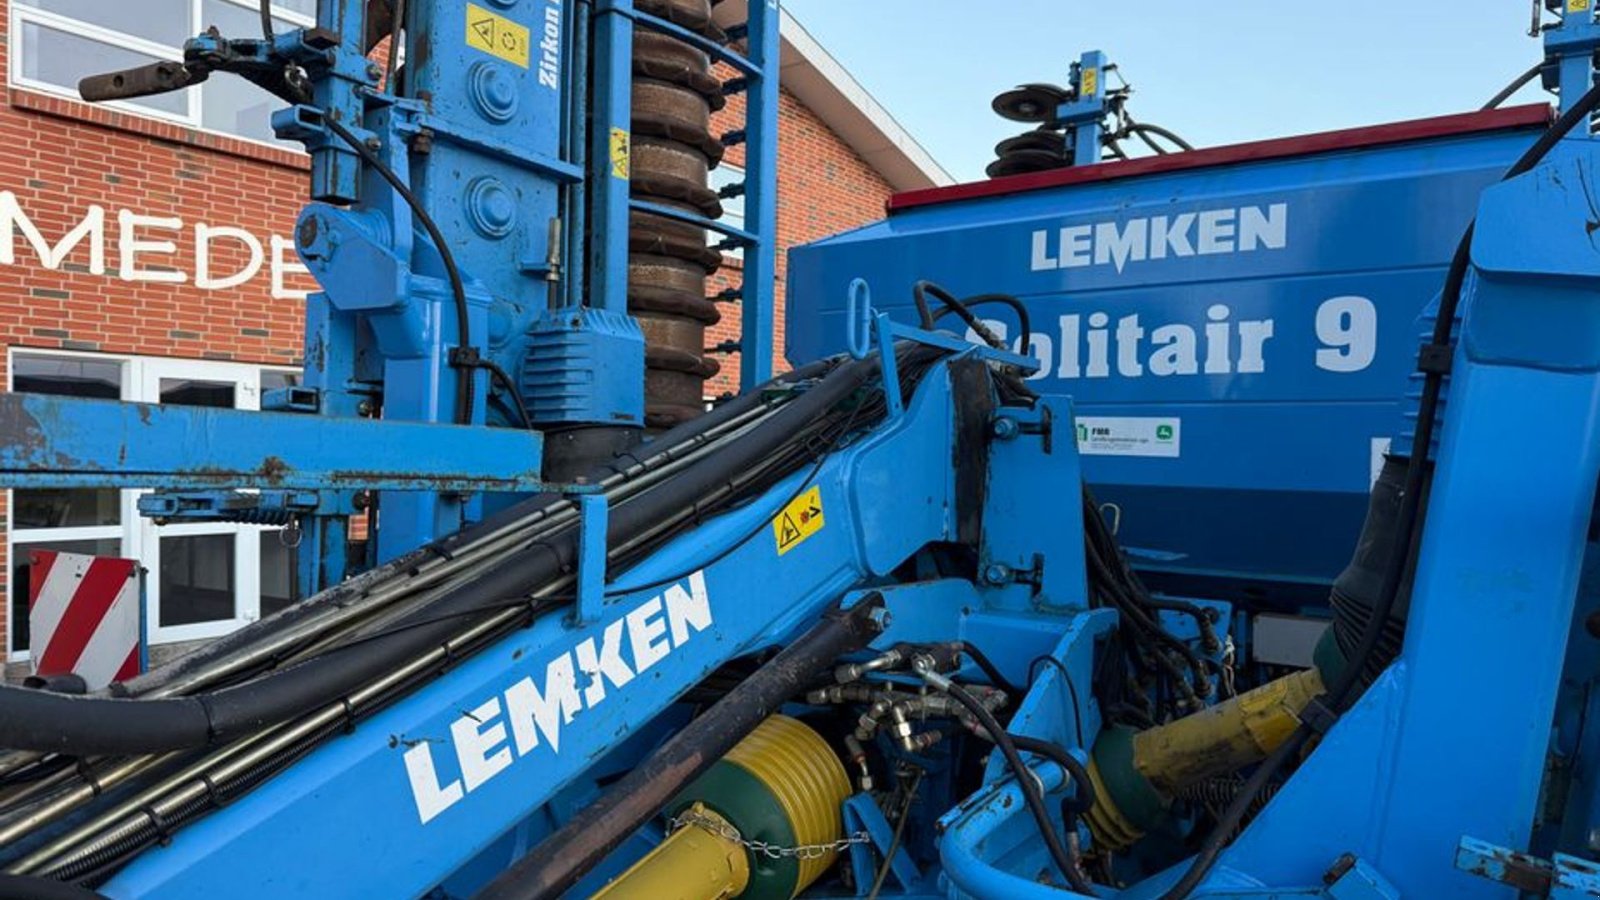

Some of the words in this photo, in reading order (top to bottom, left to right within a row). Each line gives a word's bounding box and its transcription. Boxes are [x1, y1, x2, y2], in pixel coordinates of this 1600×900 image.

[538, 6, 559, 90] Zirkon
[1031, 203, 1287, 275] LEMKEN
[1315, 296, 1377, 372] 9
[403, 569, 713, 825] LEMKEN
